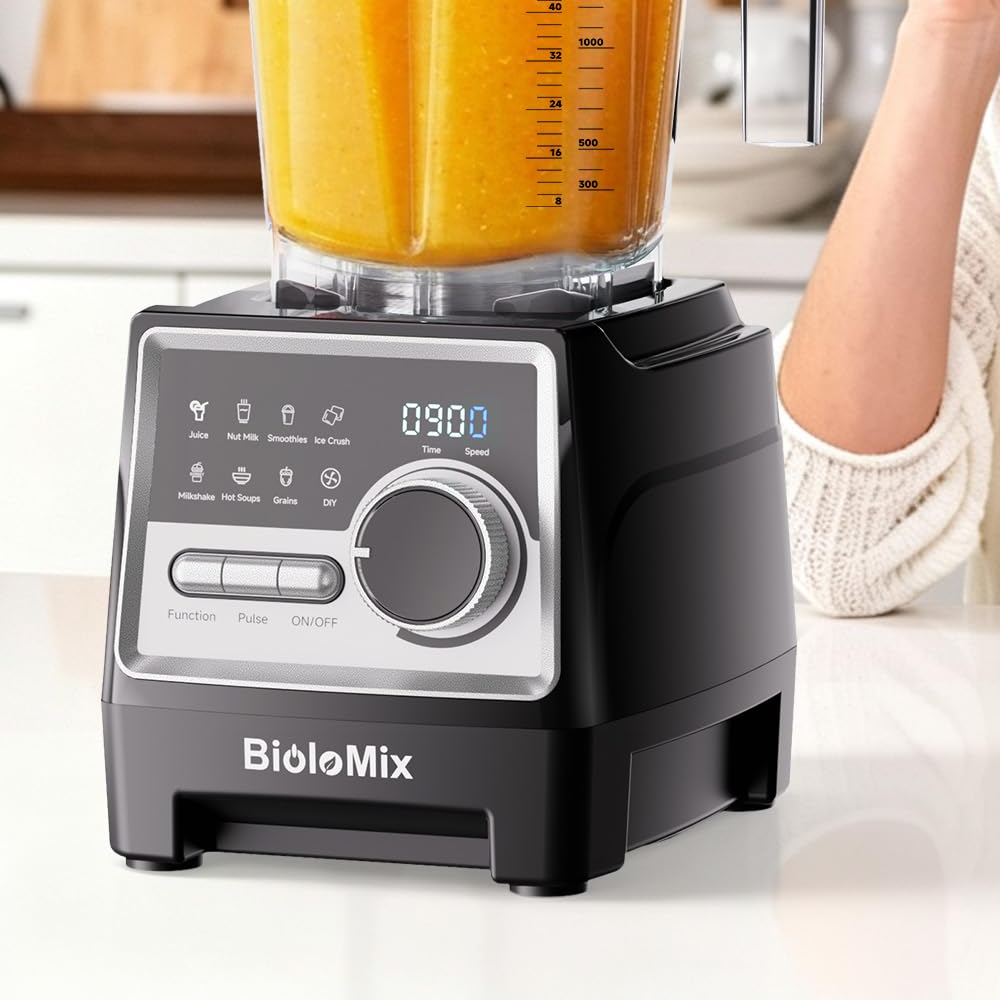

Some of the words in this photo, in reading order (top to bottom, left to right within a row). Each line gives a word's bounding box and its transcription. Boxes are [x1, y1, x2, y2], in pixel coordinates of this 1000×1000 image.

[549, 2, 562, 11] 40
[578, 37, 604, 46] 1000
[549, 51, 562, 60] 32
[549, 99, 562, 108] 24
[578, 138, 598, 147] 500
[550, 148, 562, 157] 16
[578, 179, 598, 188] 300
[555, 196, 562, 205] 8
[189, 431, 209, 439] Juice
[227, 432, 241, 441] Nut
[243, 433, 259, 442] Milk
[267, 434, 308, 444] Smoothies
[314, 436, 326, 445] Ice
[328, 437, 350, 446] Crush
[422, 445, 442, 454] Time
[465, 447, 490, 456] Speed
[178, 491, 215, 501] Milkshake
[222, 493, 236, 501] Hot
[237, 494, 260, 503] Soups
[273, 496, 298, 505] Grains
[323, 499, 337, 507] DIY
[168, 609, 216, 622] Function
[238, 612, 268, 625] Pulse
[291, 615, 338, 628] ON/OFF
[243, 737, 414, 780] BioloMix
